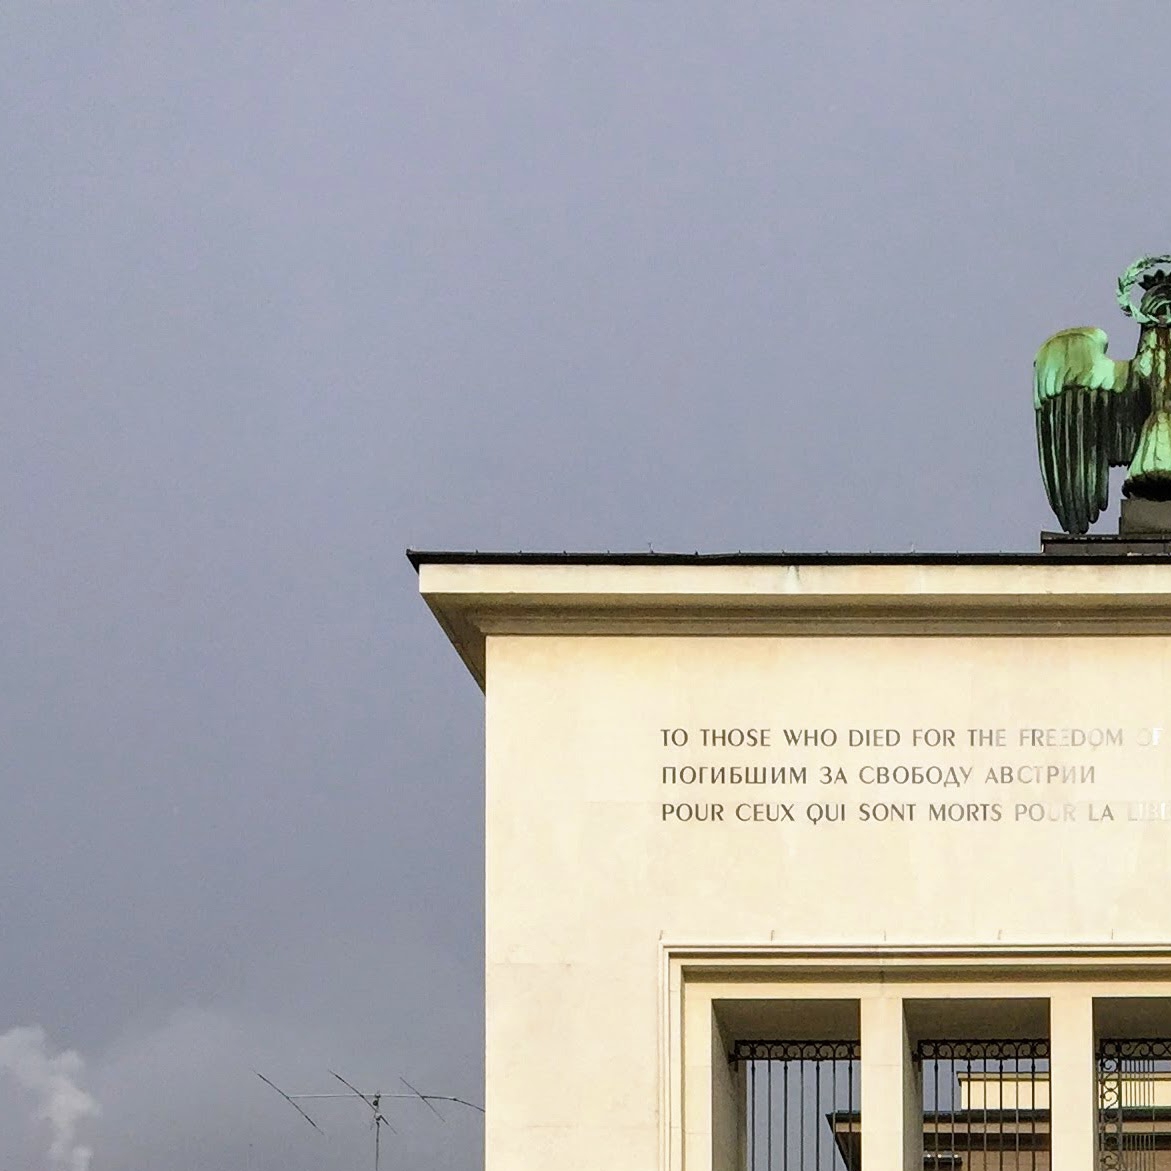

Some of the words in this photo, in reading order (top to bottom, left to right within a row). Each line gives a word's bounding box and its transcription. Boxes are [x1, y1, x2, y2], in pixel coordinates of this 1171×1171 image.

[660, 728, 689, 747] TO
[700, 728, 771, 747] THOSE
[783, 728, 838, 747] WHO
[849, 728, 901, 747] DIED
[912, 728, 956, 747] FOR
[967, 728, 1007, 747] THE
[1019, 728, 1124, 749] FREEDOM
[1136, 727, 1164, 746] OF
[661, 765, 807, 785] ПОГИБШИМ
[819, 765, 848, 785] ЗА
[858, 765, 973, 787] СВОБОДУ
[984, 765, 1096, 784] АВСТРИИ
[661, 803, 725, 822] POUR
[735, 803, 796, 822] CEUX
[806, 803, 846, 825] QUI
[858, 803, 917, 822] SONT
[928, 803, 1002, 822] MORTS
[1014, 803, 1077, 822] POUR
[1088, 803, 1115, 822] LA
